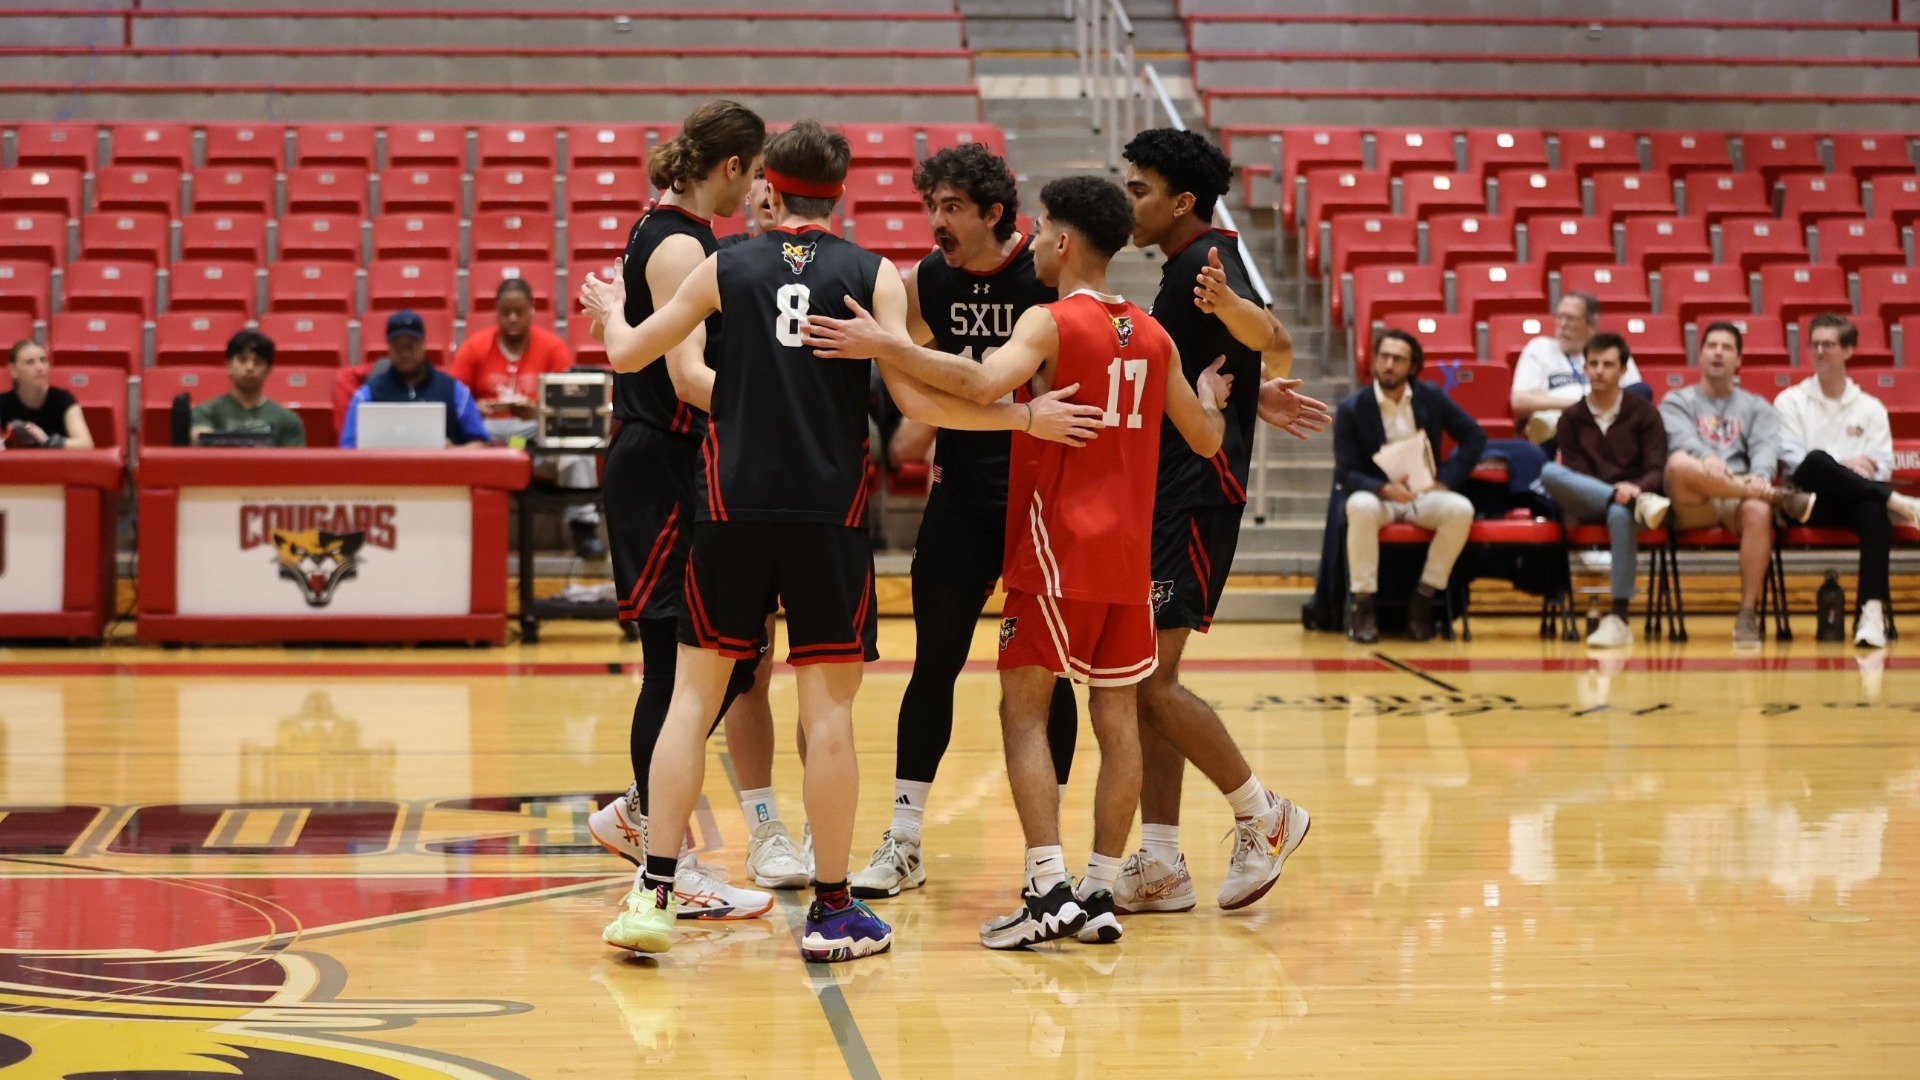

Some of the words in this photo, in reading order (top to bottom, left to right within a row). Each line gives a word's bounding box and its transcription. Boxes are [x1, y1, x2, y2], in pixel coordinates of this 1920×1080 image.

[776, 283, 811, 347] 8
[950, 302, 1014, 337] SXU
[1102, 357, 1148, 428] 17
[240, 504, 396, 551] COUGARS
